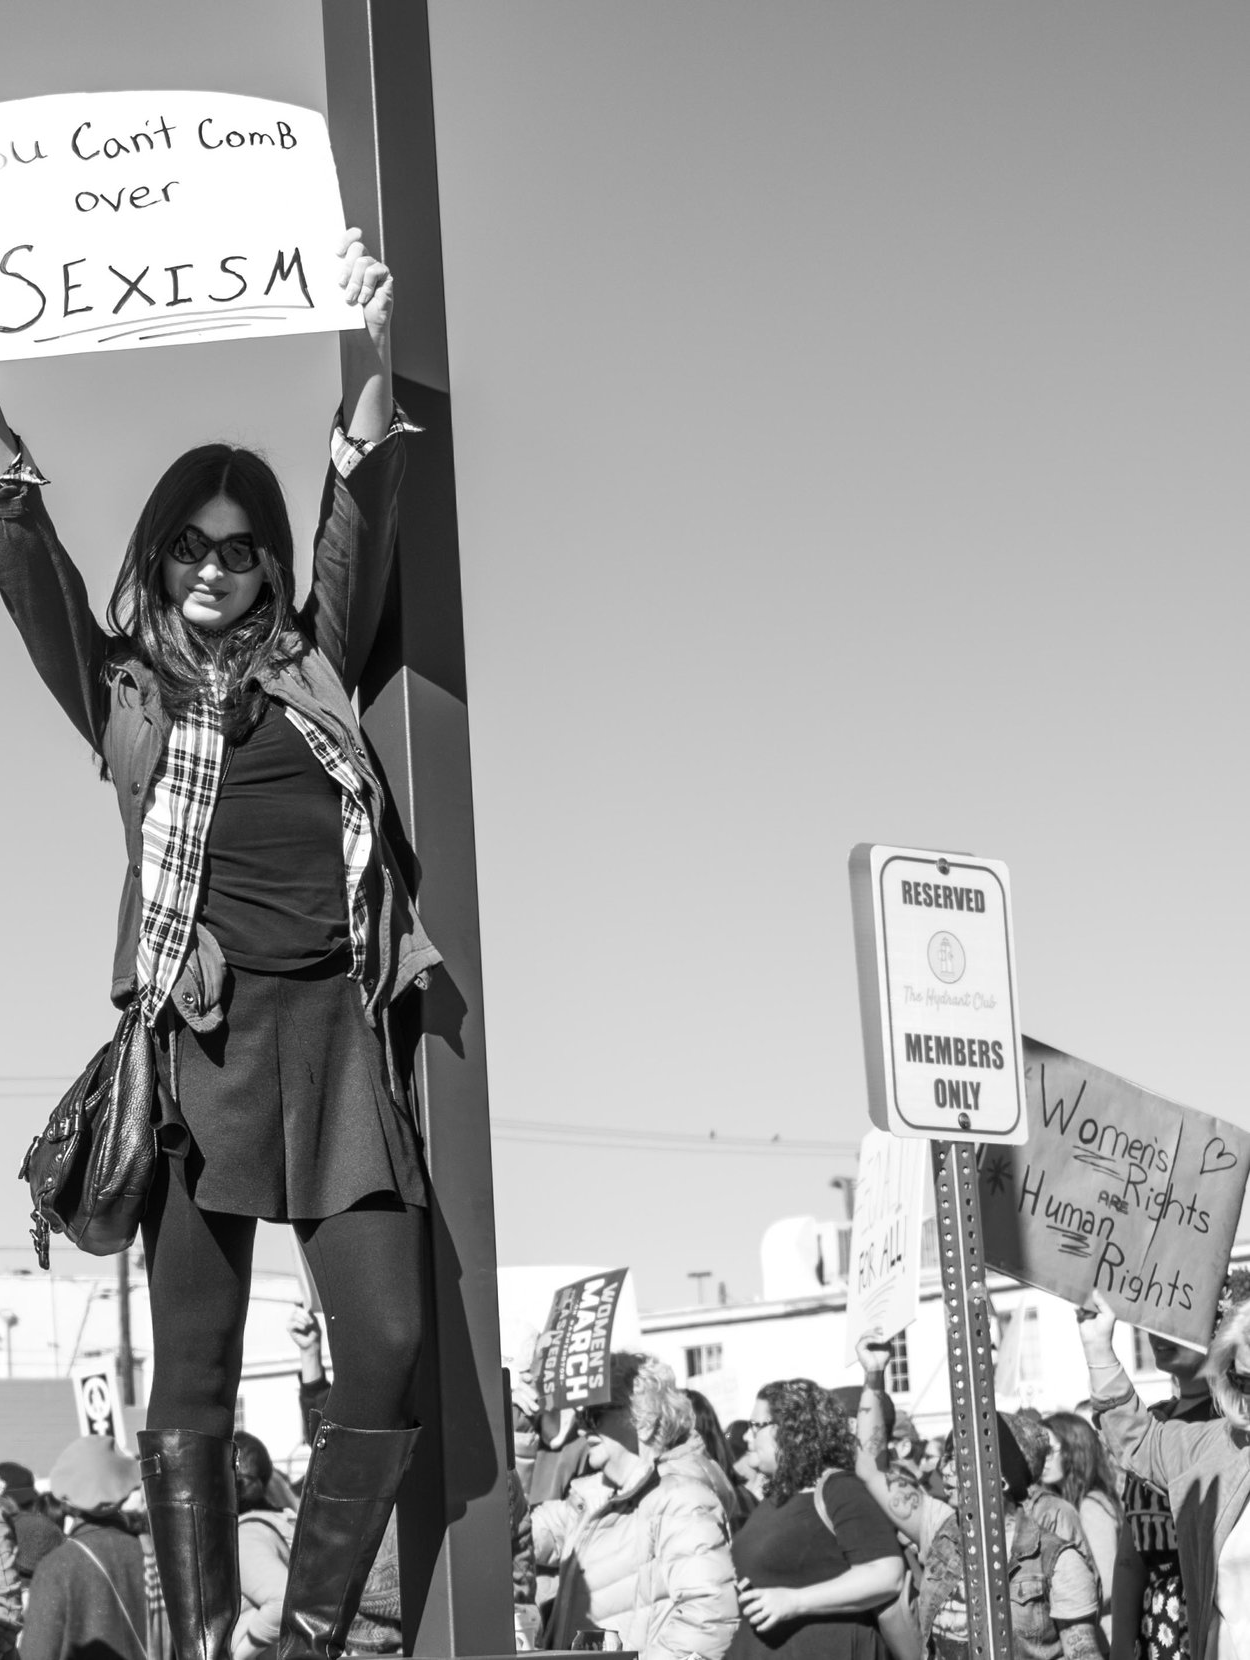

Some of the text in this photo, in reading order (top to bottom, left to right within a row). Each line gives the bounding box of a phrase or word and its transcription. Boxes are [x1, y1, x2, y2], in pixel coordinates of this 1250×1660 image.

[70, 115, 177, 160] Can't
[74, 180, 180, 213] over
[901, 880, 986, 914] RESERVED
[903, 985, 997, 1012] The Hydrant Club
[904, 1032, 1005, 1071] MEMBERS
[933, 1078, 982, 1112] ONLY
[1040, 1062, 1169, 1173] Women's
[1018, 1164, 1115, 1241] Human
[1122, 1162, 1210, 1234] Rights
[1092, 1241, 1194, 1311] Rights
[565, 1278, 606, 1401] MARCH
[588, 1281, 619, 1389] WOMEN'S
